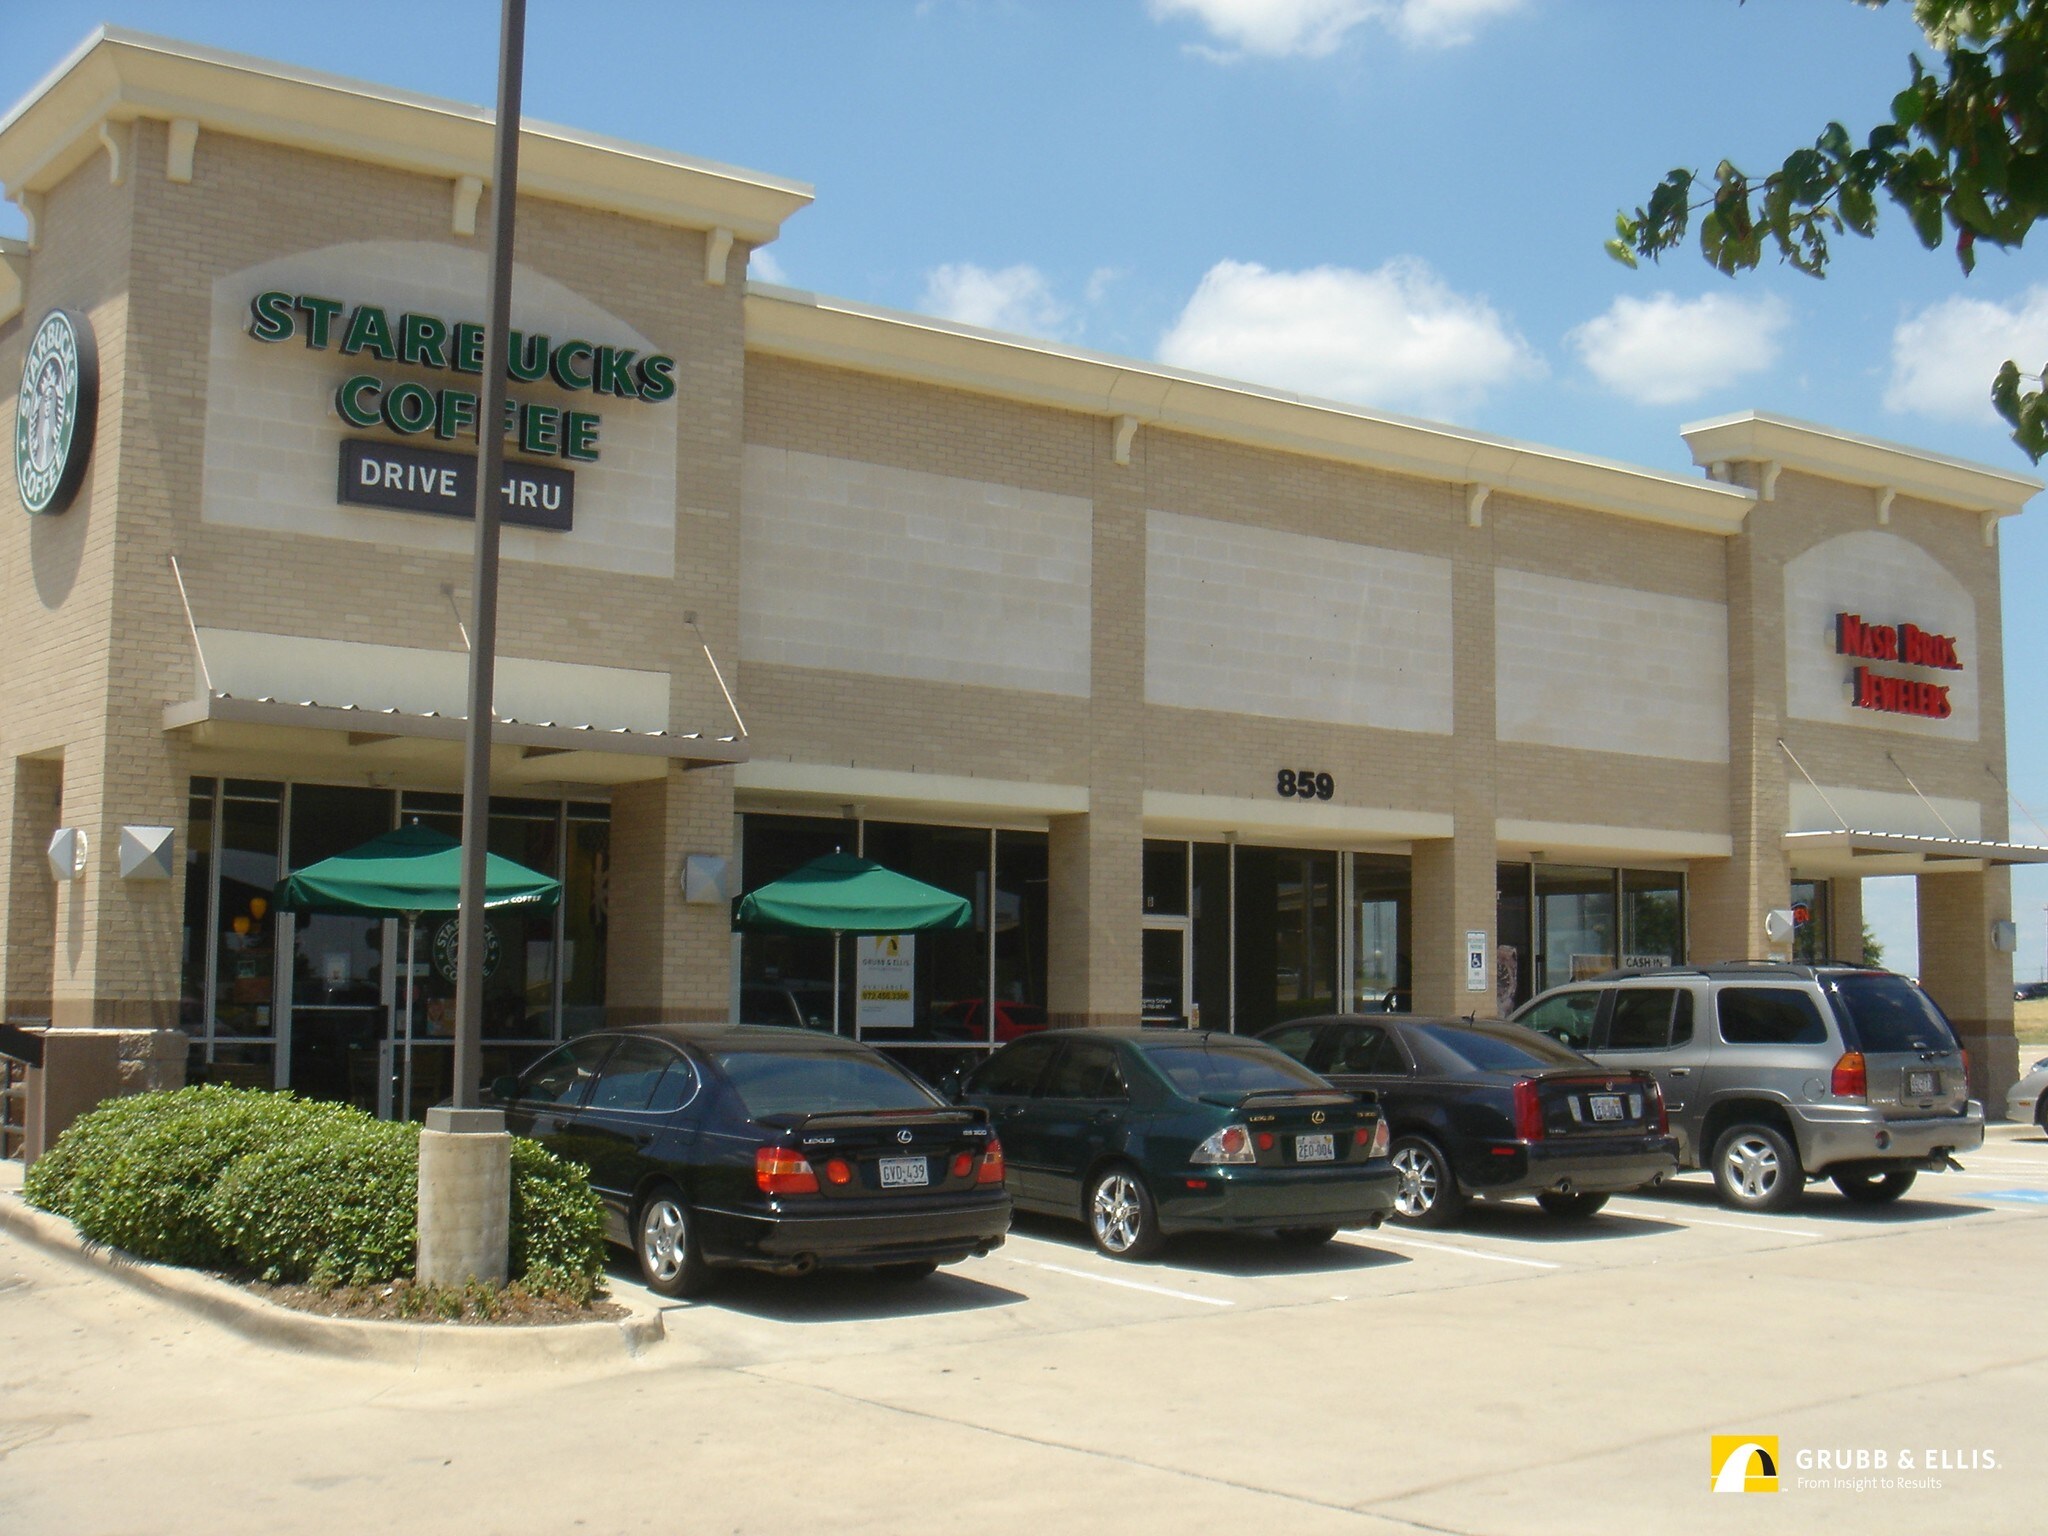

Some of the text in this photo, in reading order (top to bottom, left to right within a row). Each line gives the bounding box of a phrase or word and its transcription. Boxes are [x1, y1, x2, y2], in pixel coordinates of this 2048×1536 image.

[19, 321, 75, 418] STARBUCKS
[250, 290, 677, 403] STARBUCKS
[22, 448, 64, 501] COFFEE
[360, 458, 561, 510] DRIVE HRU
[1277, 769, 1335, 800] 859
[1626, 957, 1650, 967] CASH
